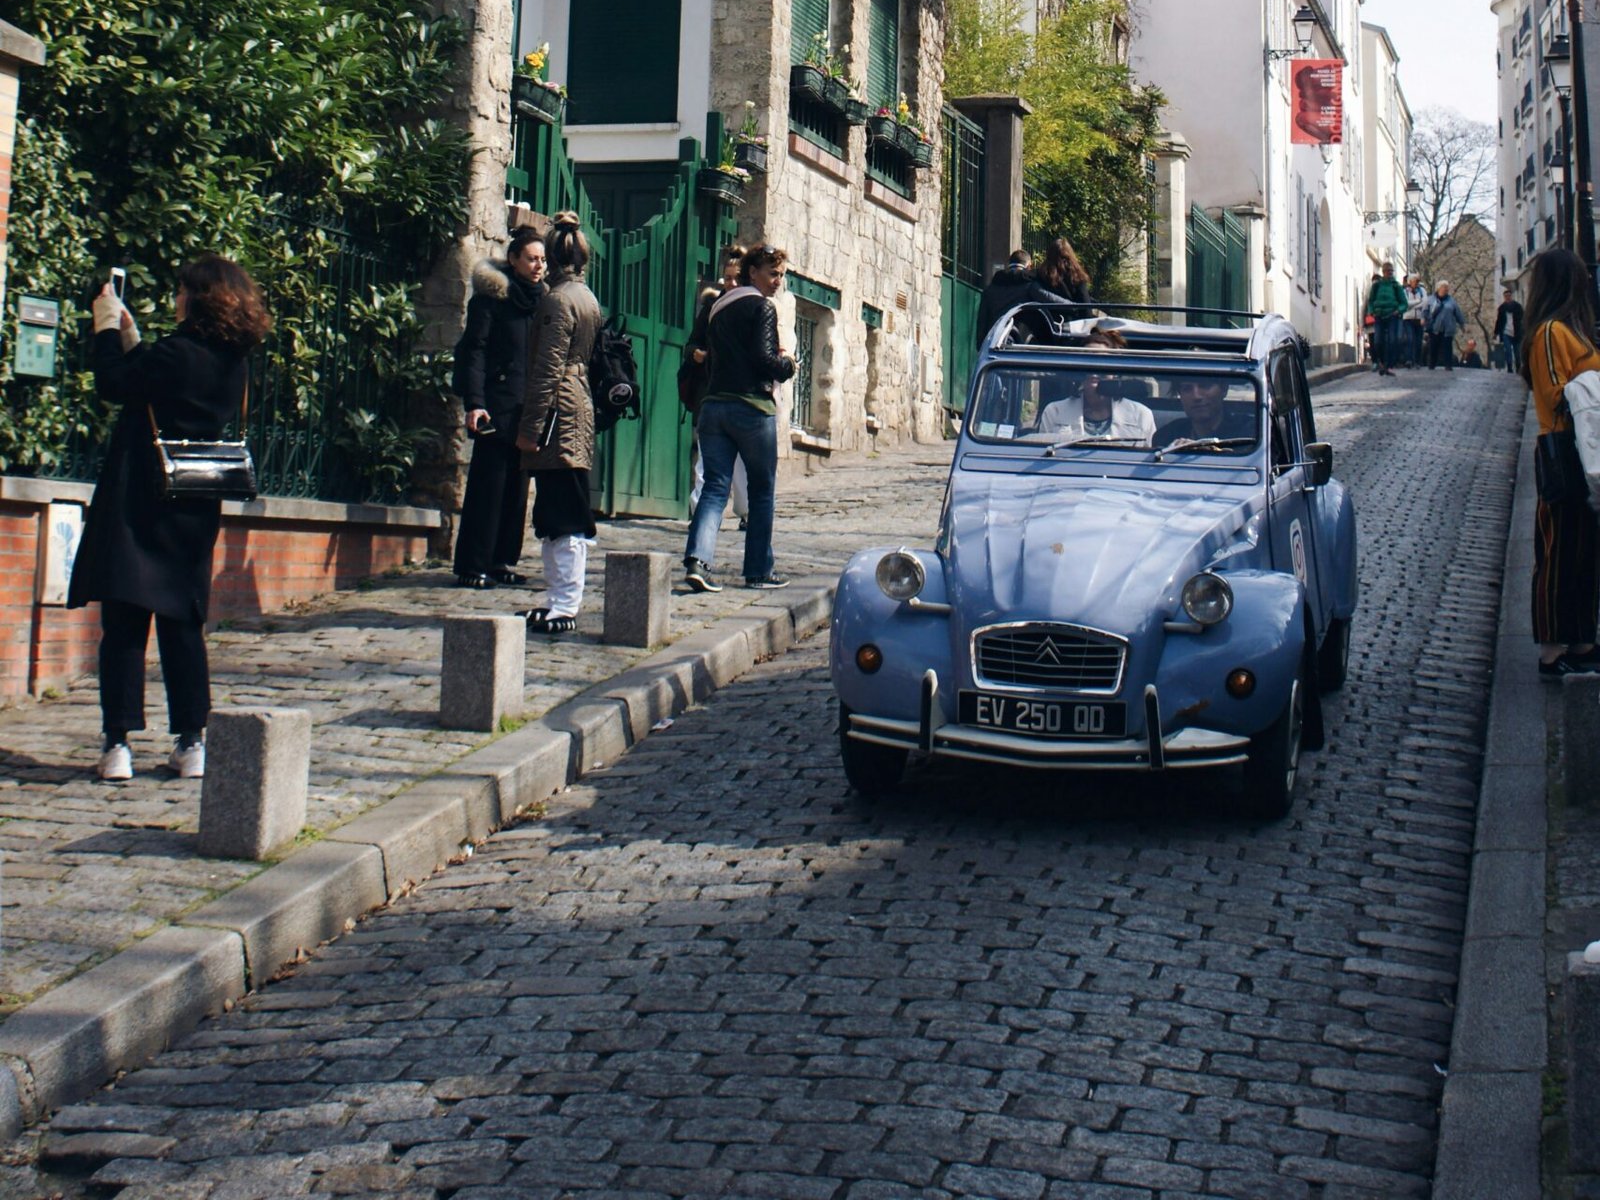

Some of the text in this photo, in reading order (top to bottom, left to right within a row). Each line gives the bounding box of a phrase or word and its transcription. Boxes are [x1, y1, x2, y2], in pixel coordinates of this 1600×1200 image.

[976, 696, 1105, 733] EV 250 QD
